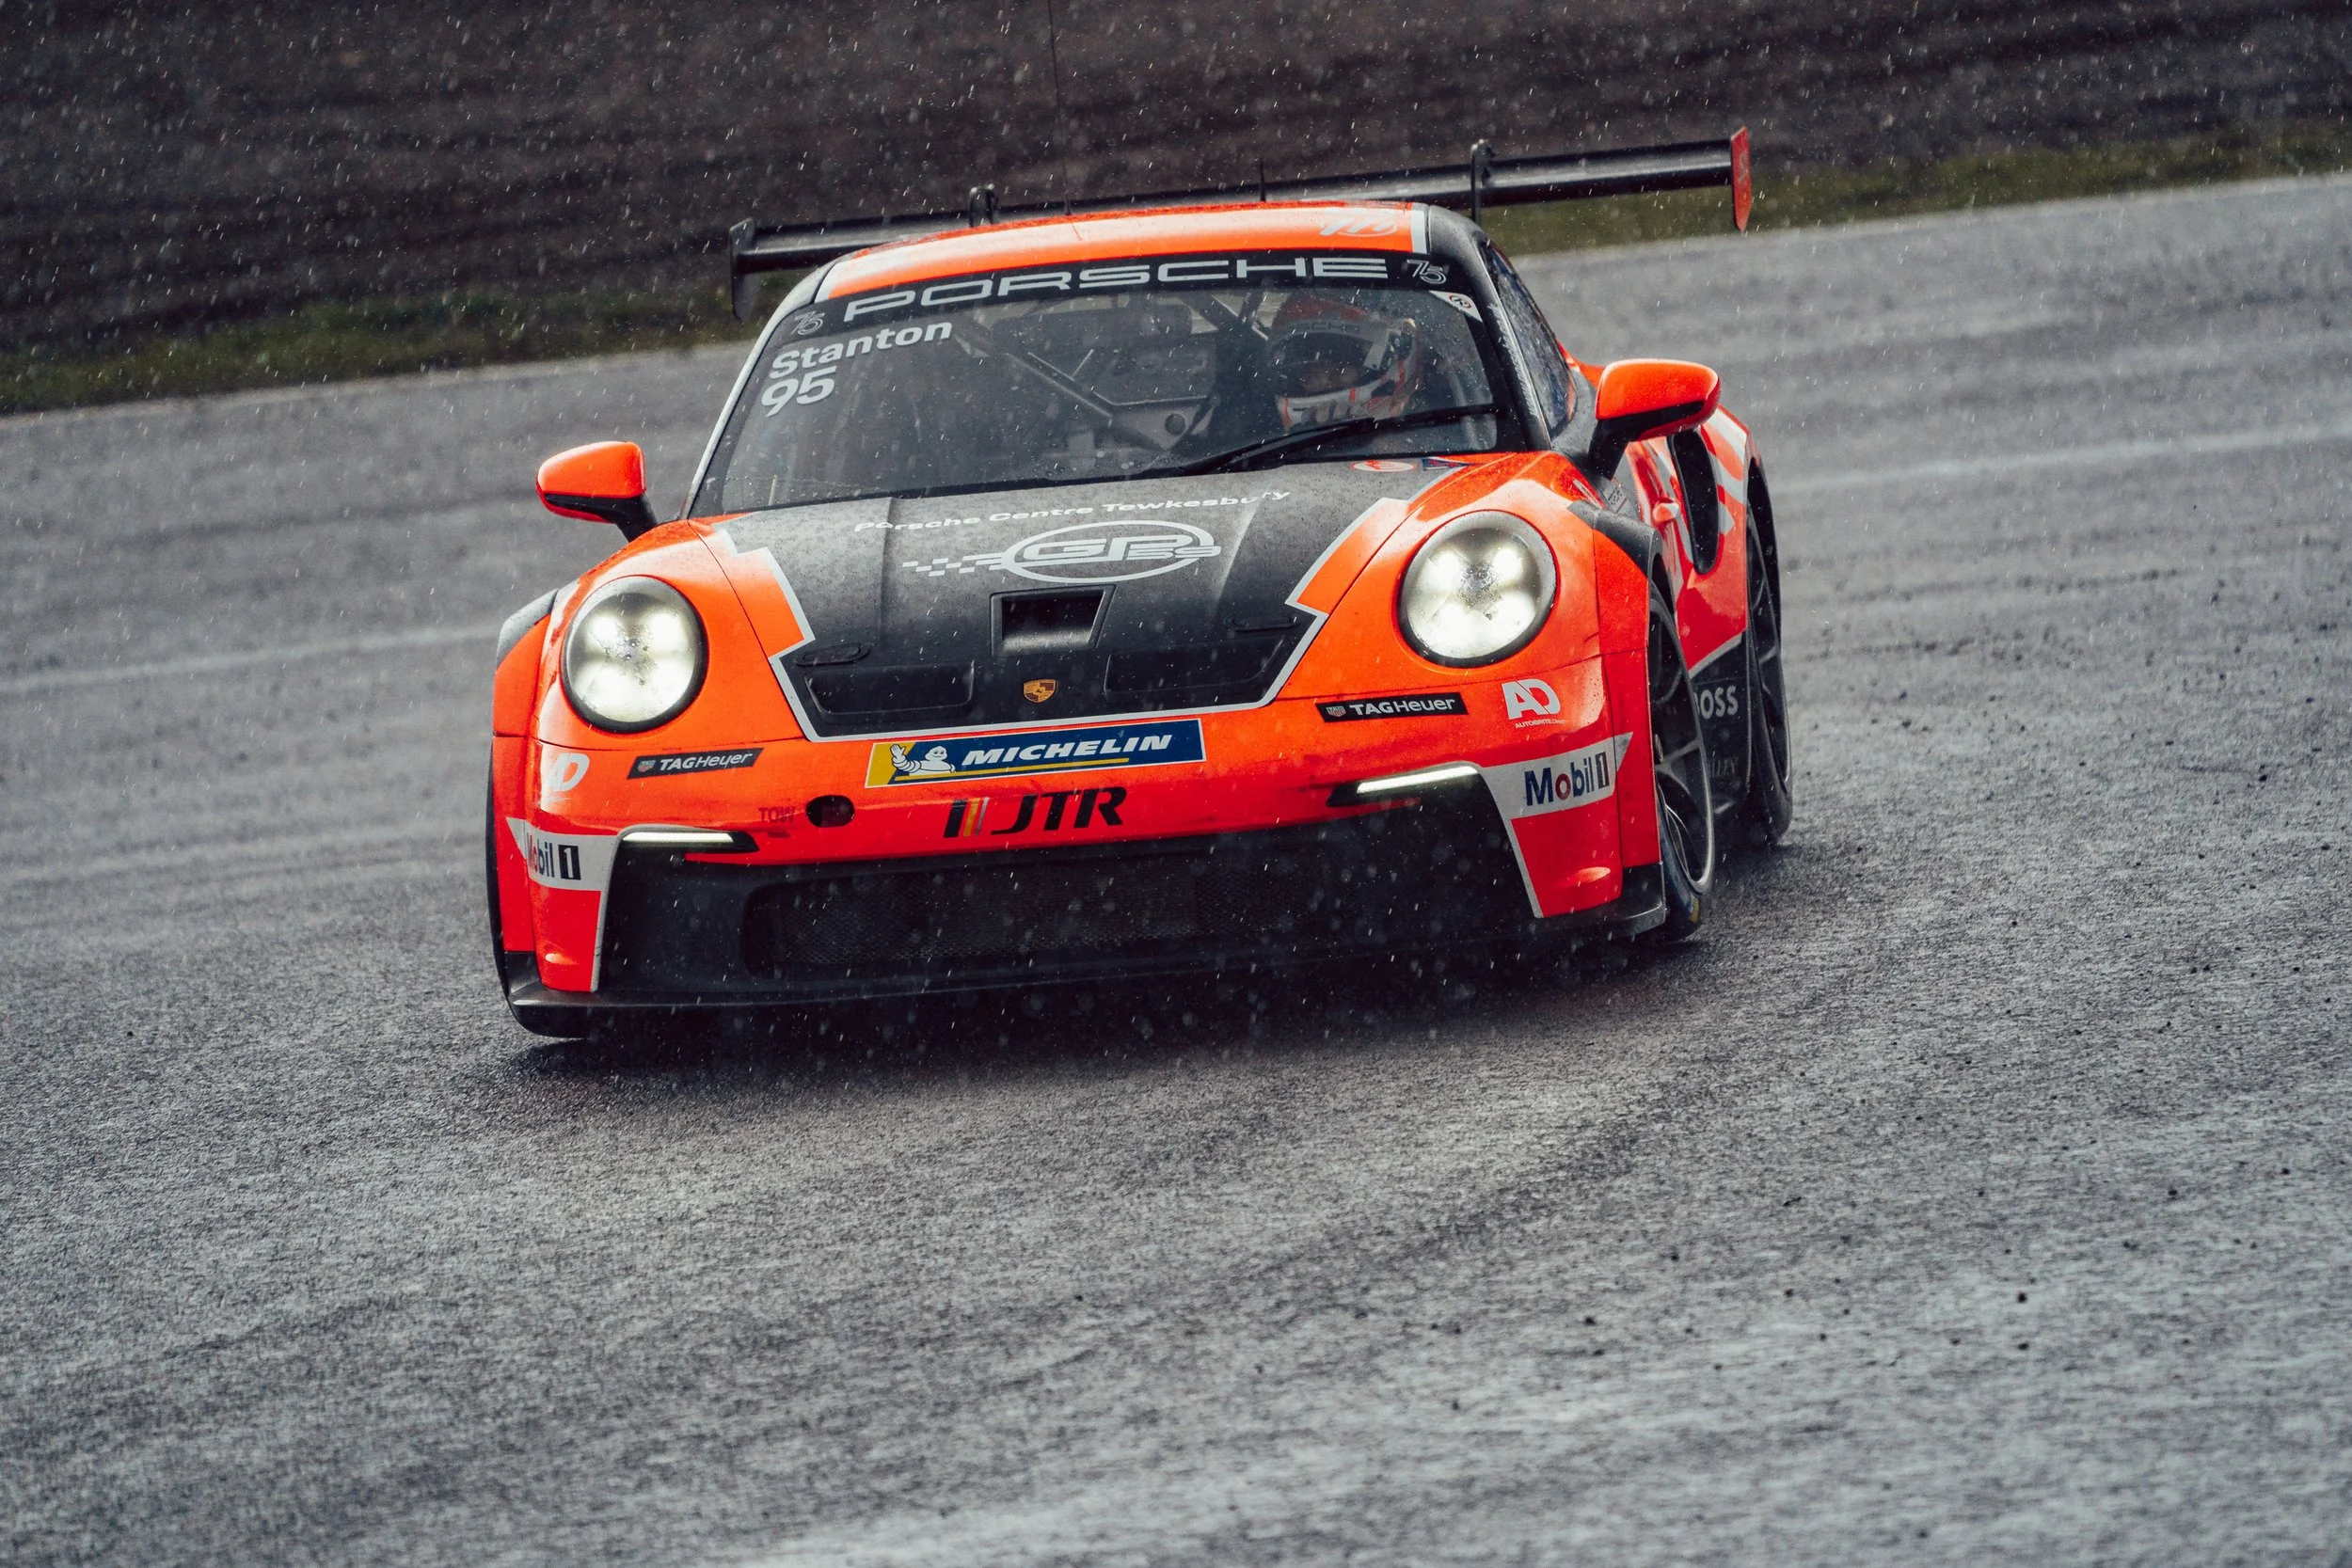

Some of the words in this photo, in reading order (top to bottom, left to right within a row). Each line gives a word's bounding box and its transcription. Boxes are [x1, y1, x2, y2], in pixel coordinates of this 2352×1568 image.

[843, 258, 1388, 322] PORSCHE
[1406, 259, 1447, 284] 75
[769, 322, 952, 379] Stanton
[761, 366, 836, 418] 95
[854, 517, 981, 531] Porsche
[989, 506, 1093, 521] Centre
[1693, 685, 1739, 720] OSS
[961, 735, 1173, 766] MICHELIN
[1524, 756, 1595, 806] Mobil
[757, 806, 796, 823] TOW
[991, 786, 1127, 835] JTR
